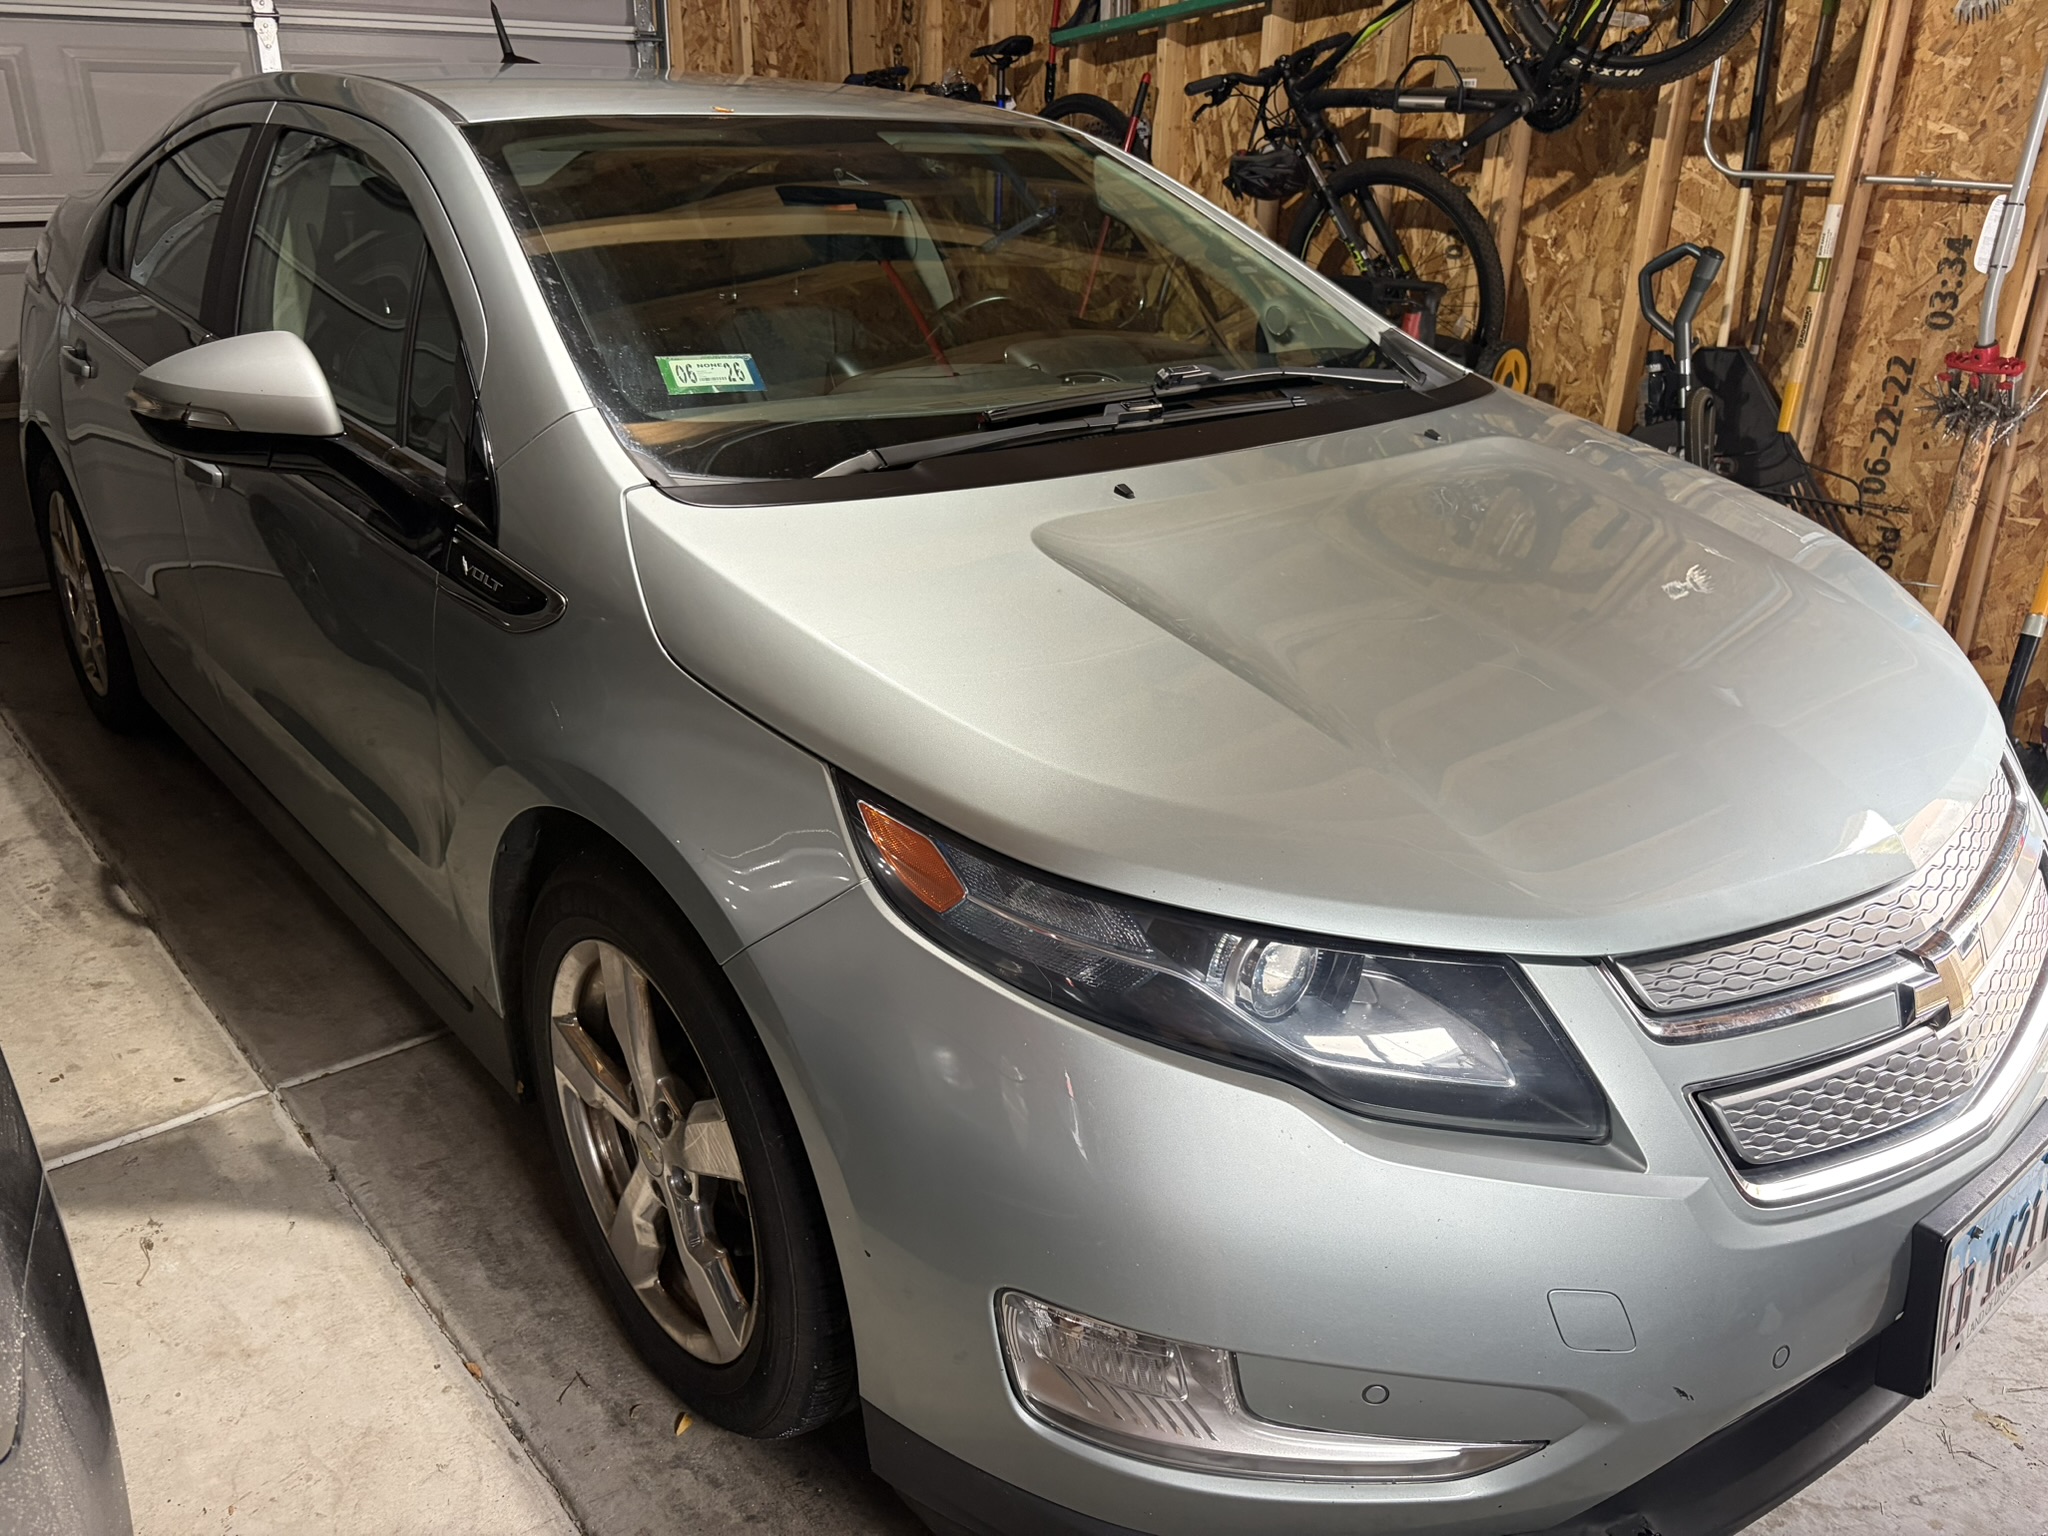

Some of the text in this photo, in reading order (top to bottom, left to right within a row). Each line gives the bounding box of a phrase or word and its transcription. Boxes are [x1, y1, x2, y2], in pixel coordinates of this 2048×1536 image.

[1925, 234, 1973, 330] 03:34
[675, 364, 698, 384] 06
[723, 361, 746, 382] 26
[1859, 355, 1917, 496] 06-22-22
[462, 555, 504, 592] VOLT
